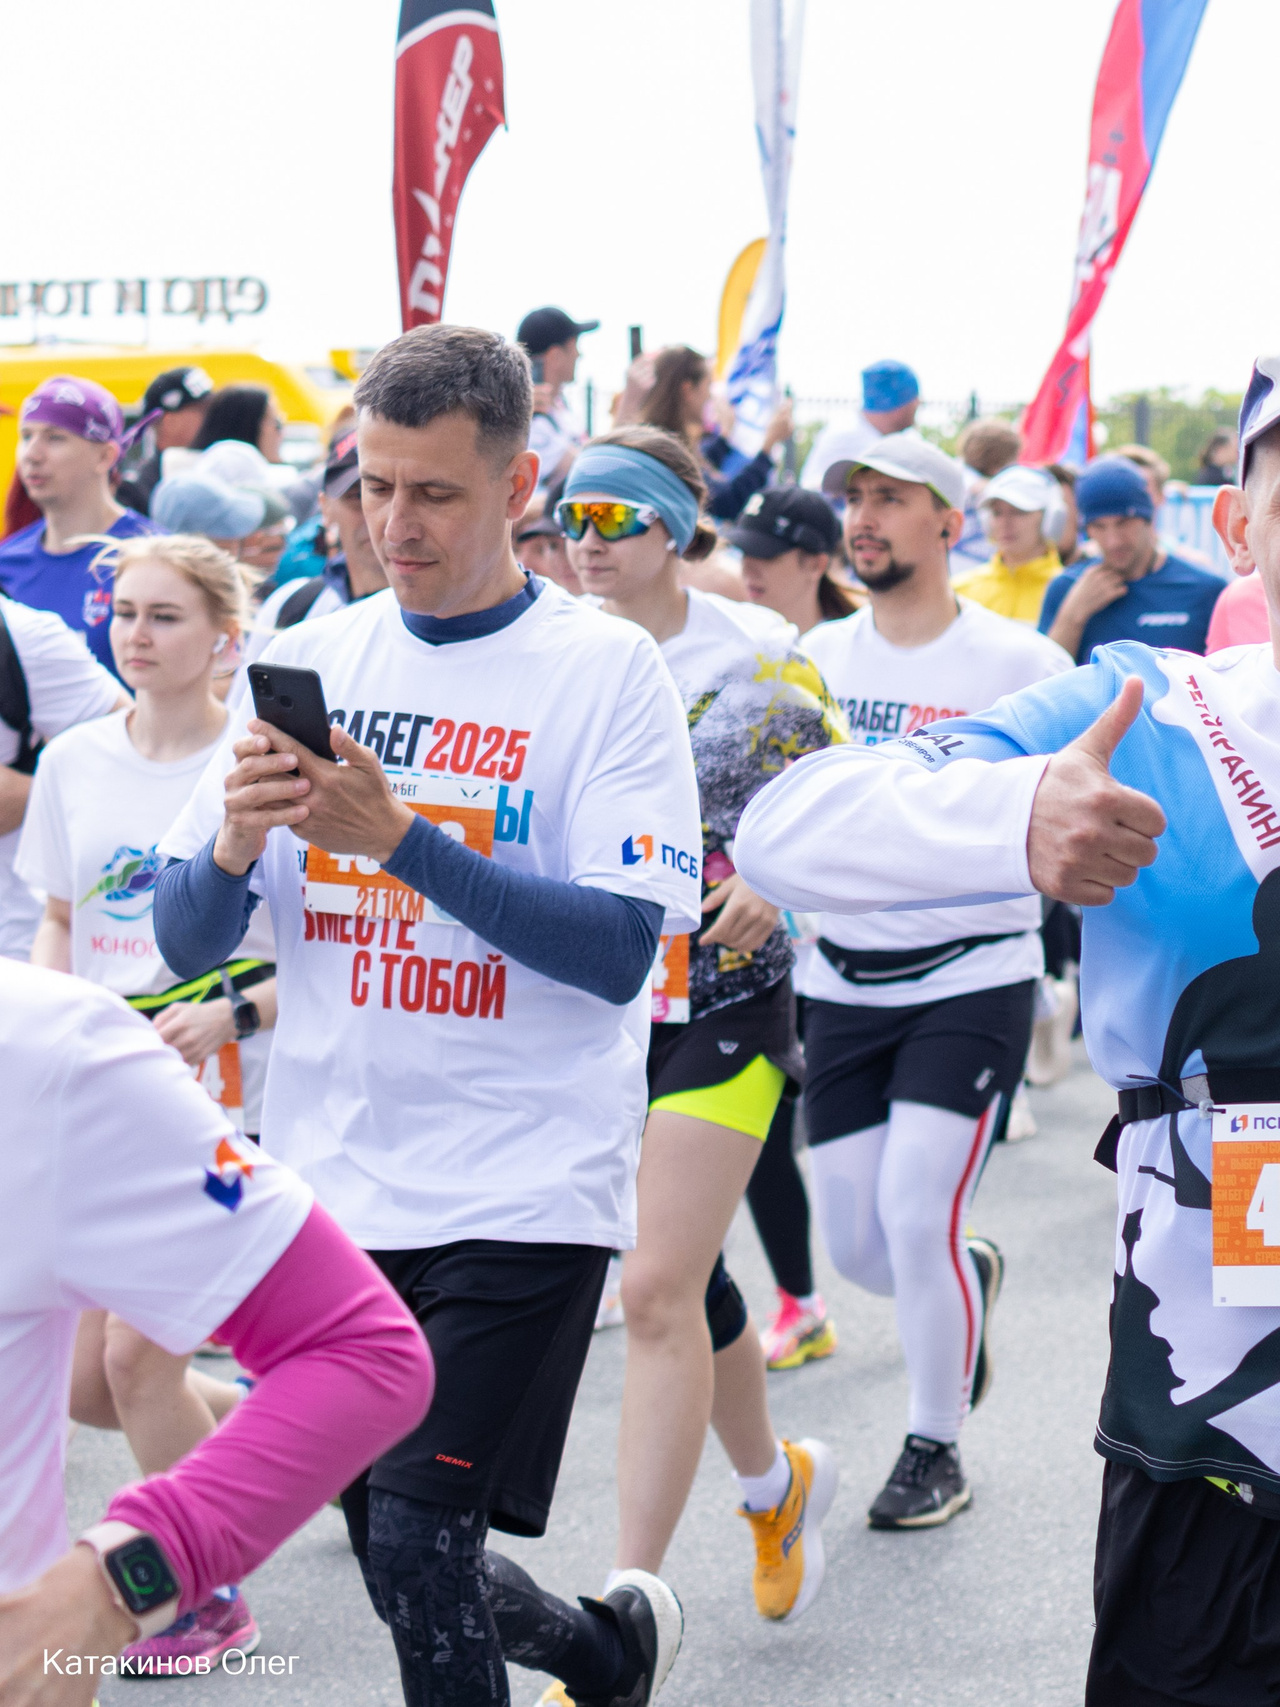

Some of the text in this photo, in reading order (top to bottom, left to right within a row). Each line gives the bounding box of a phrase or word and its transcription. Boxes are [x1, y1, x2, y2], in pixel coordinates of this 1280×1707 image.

[661, 843, 699, 880] ПСБ
[91, 935, 159, 959] ЮНОС
[351, 950, 507, 1021] С ТОБОЙ
[435, 1453, 473, 1470] DEMIX
[486, 1659, 499, 1700] DEMIX
